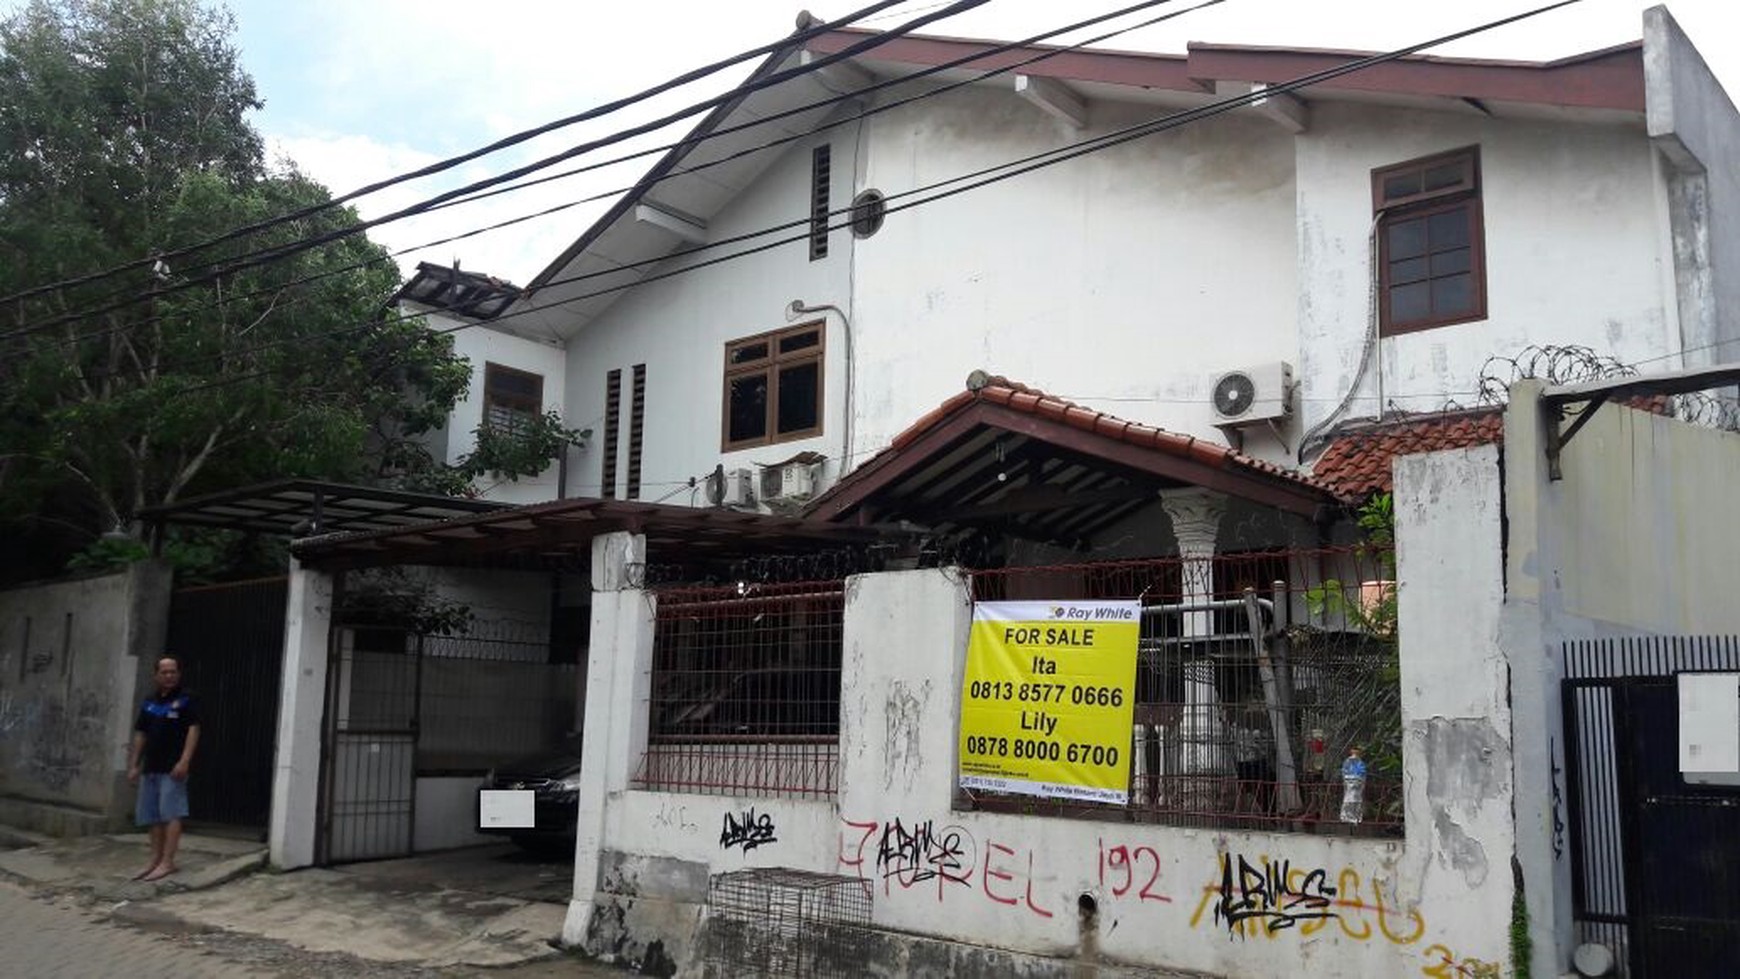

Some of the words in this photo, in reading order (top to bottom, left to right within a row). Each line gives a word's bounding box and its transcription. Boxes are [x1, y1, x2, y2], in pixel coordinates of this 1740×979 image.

[1067, 606, 1093, 620] Ray
[1095, 607, 1133, 620] White
[1004, 628, 1041, 645] FOR
[1045, 628, 1095, 646] SALE
[1031, 655, 1056, 675] Ita
[970, 680, 1013, 701] 0813
[1018, 683, 1066, 703] 8577
[1071, 685, 1124, 707] 0666
[1020, 711, 1058, 736] Lily
[966, 735, 1008, 757] 0878
[1013, 740, 1060, 762] 8000
[1066, 743, 1119, 767] 6700
